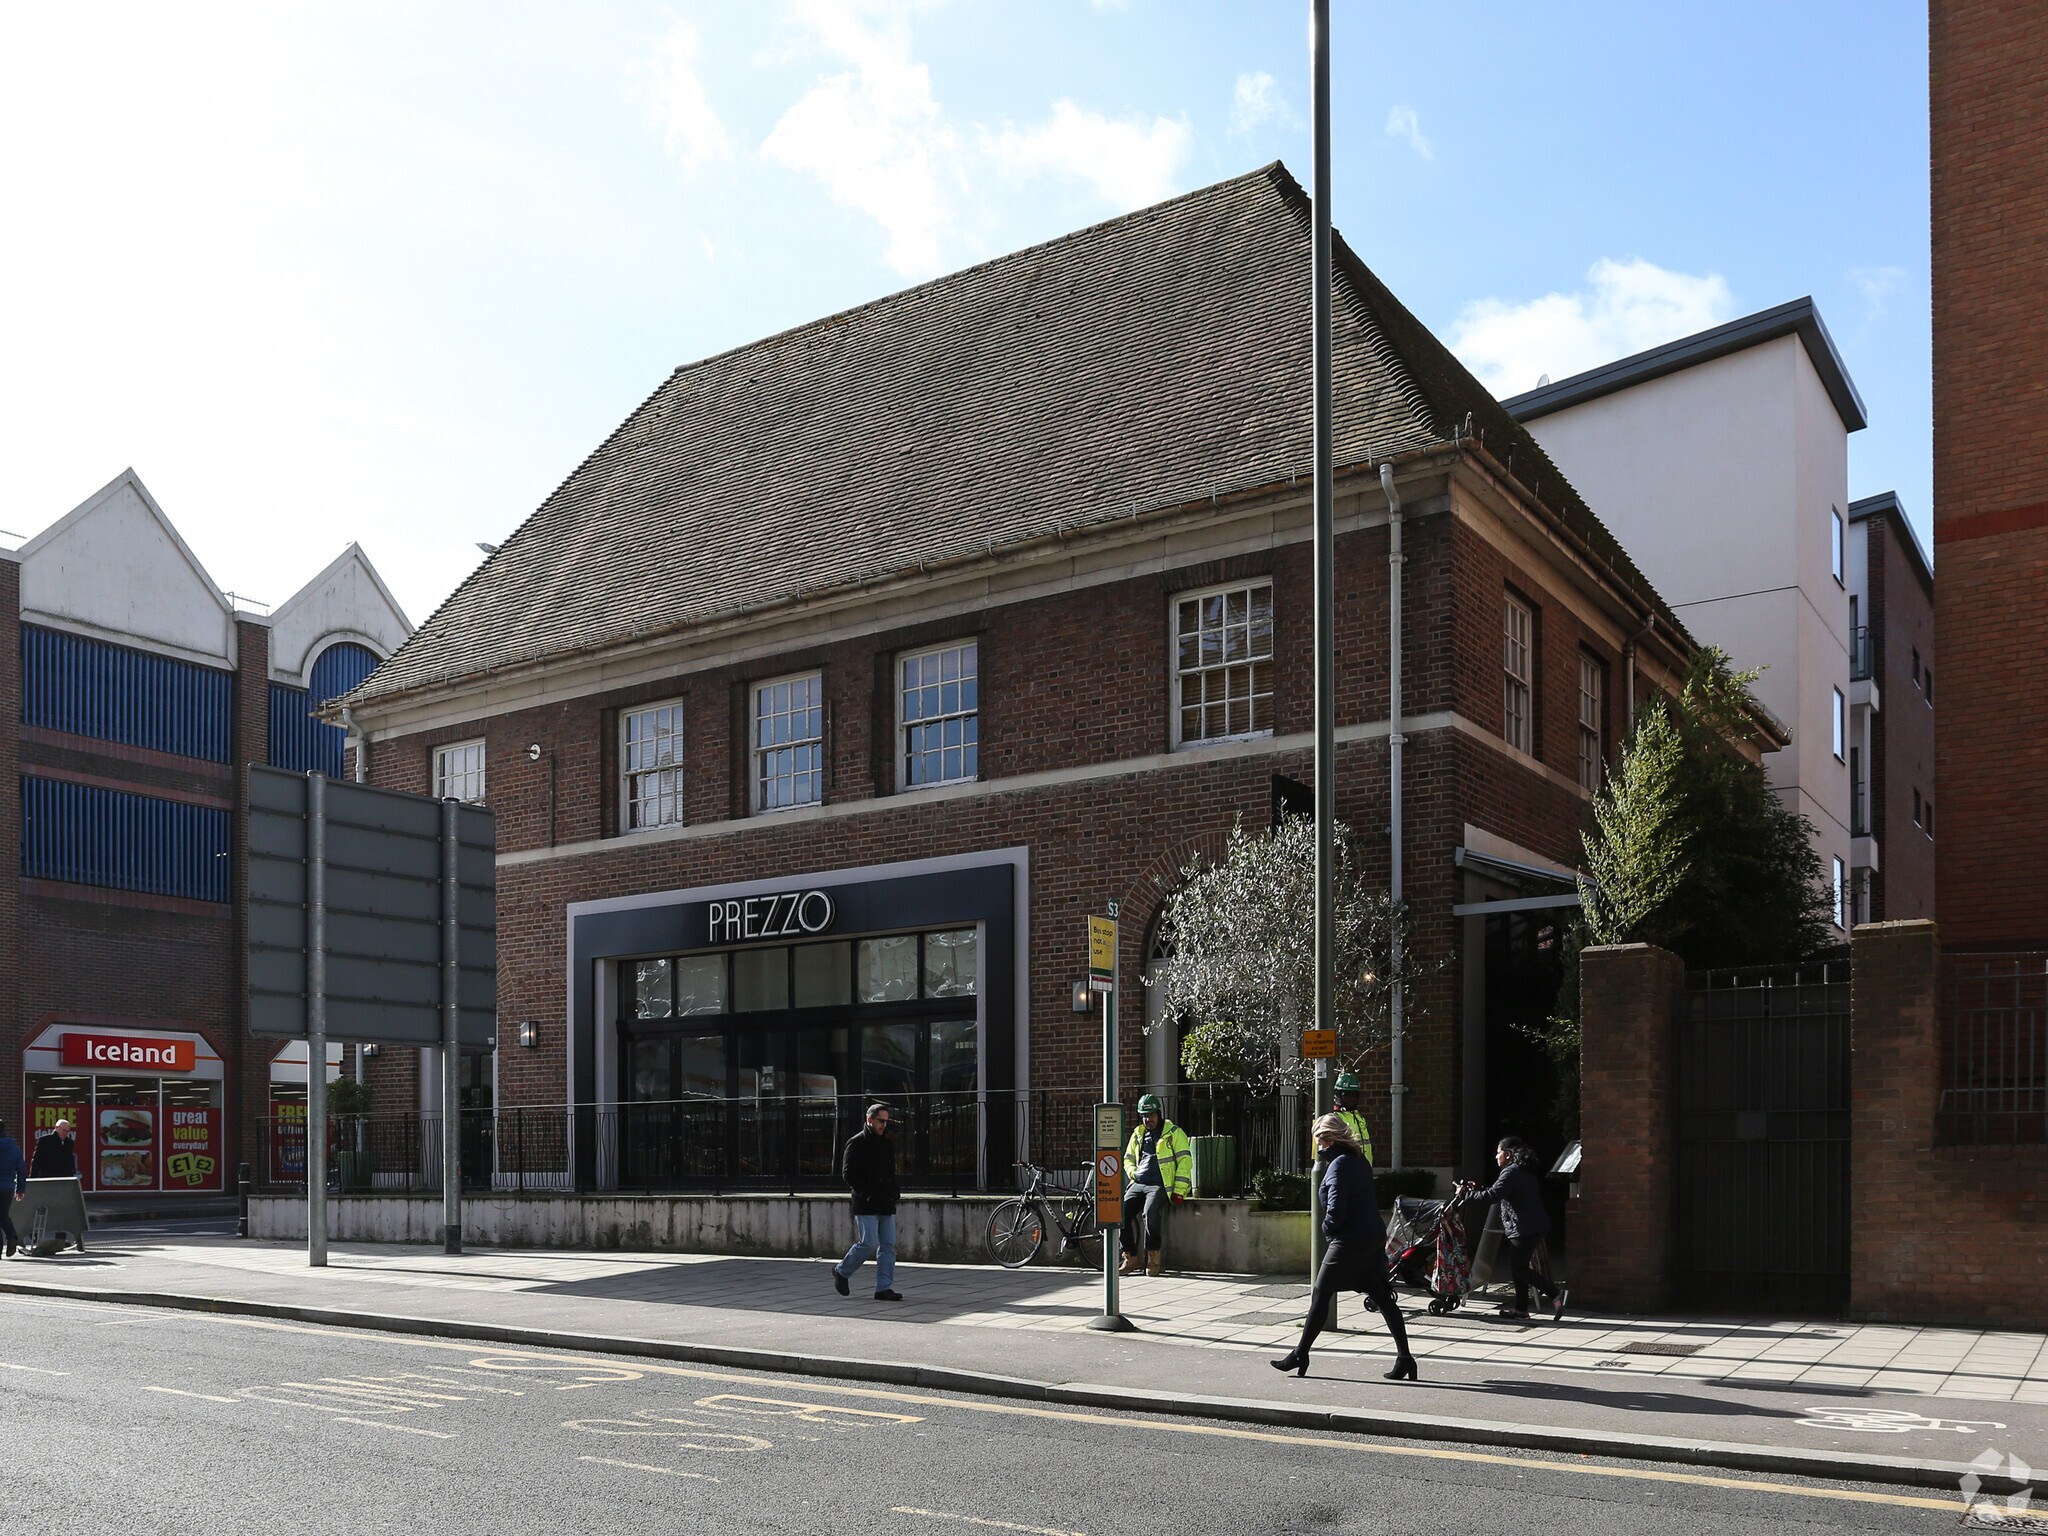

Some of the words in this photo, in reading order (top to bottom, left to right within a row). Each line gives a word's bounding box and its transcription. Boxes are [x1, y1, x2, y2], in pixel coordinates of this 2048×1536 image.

[709, 890, 832, 942] PREZZO
[1108, 902, 1119, 917] S3
[1093, 926, 1102, 934] Bus
[1102, 928, 1114, 938] stop
[1093, 937, 1102, 945] not
[86, 1040, 177, 1065] Iceland
[172, 1111, 208, 1126] great
[172, 1126, 208, 1140] value
[172, 1141, 208, 1150] everyday!
[172, 1156, 191, 1174] £1
[196, 1158, 212, 1171] £2
[189, 1174, 201, 1183] £3
